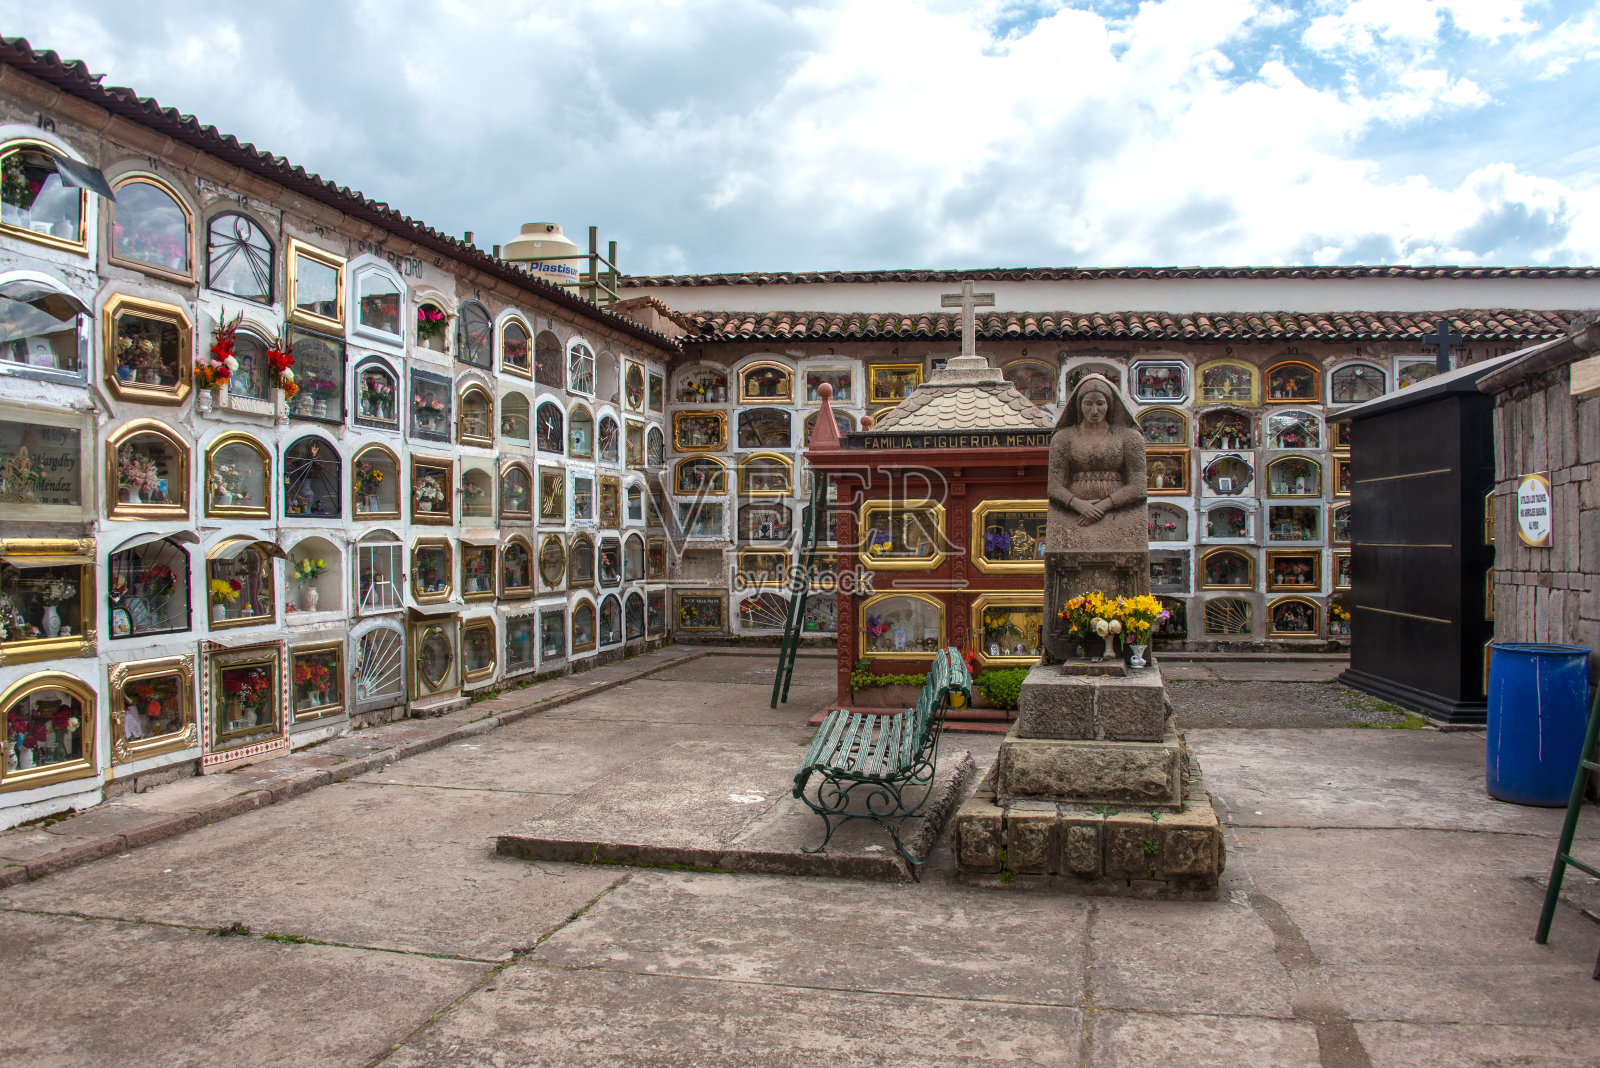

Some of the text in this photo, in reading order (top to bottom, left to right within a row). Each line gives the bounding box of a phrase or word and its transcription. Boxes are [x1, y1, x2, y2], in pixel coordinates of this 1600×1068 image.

[529, 261, 578, 276] Plastisur
[1021, 346, 1028, 357] 6
[1287, 346, 1299, 356] 10
[864, 437, 913, 449] FAMILIA
[923, 435, 999, 449] FIGUEROA
